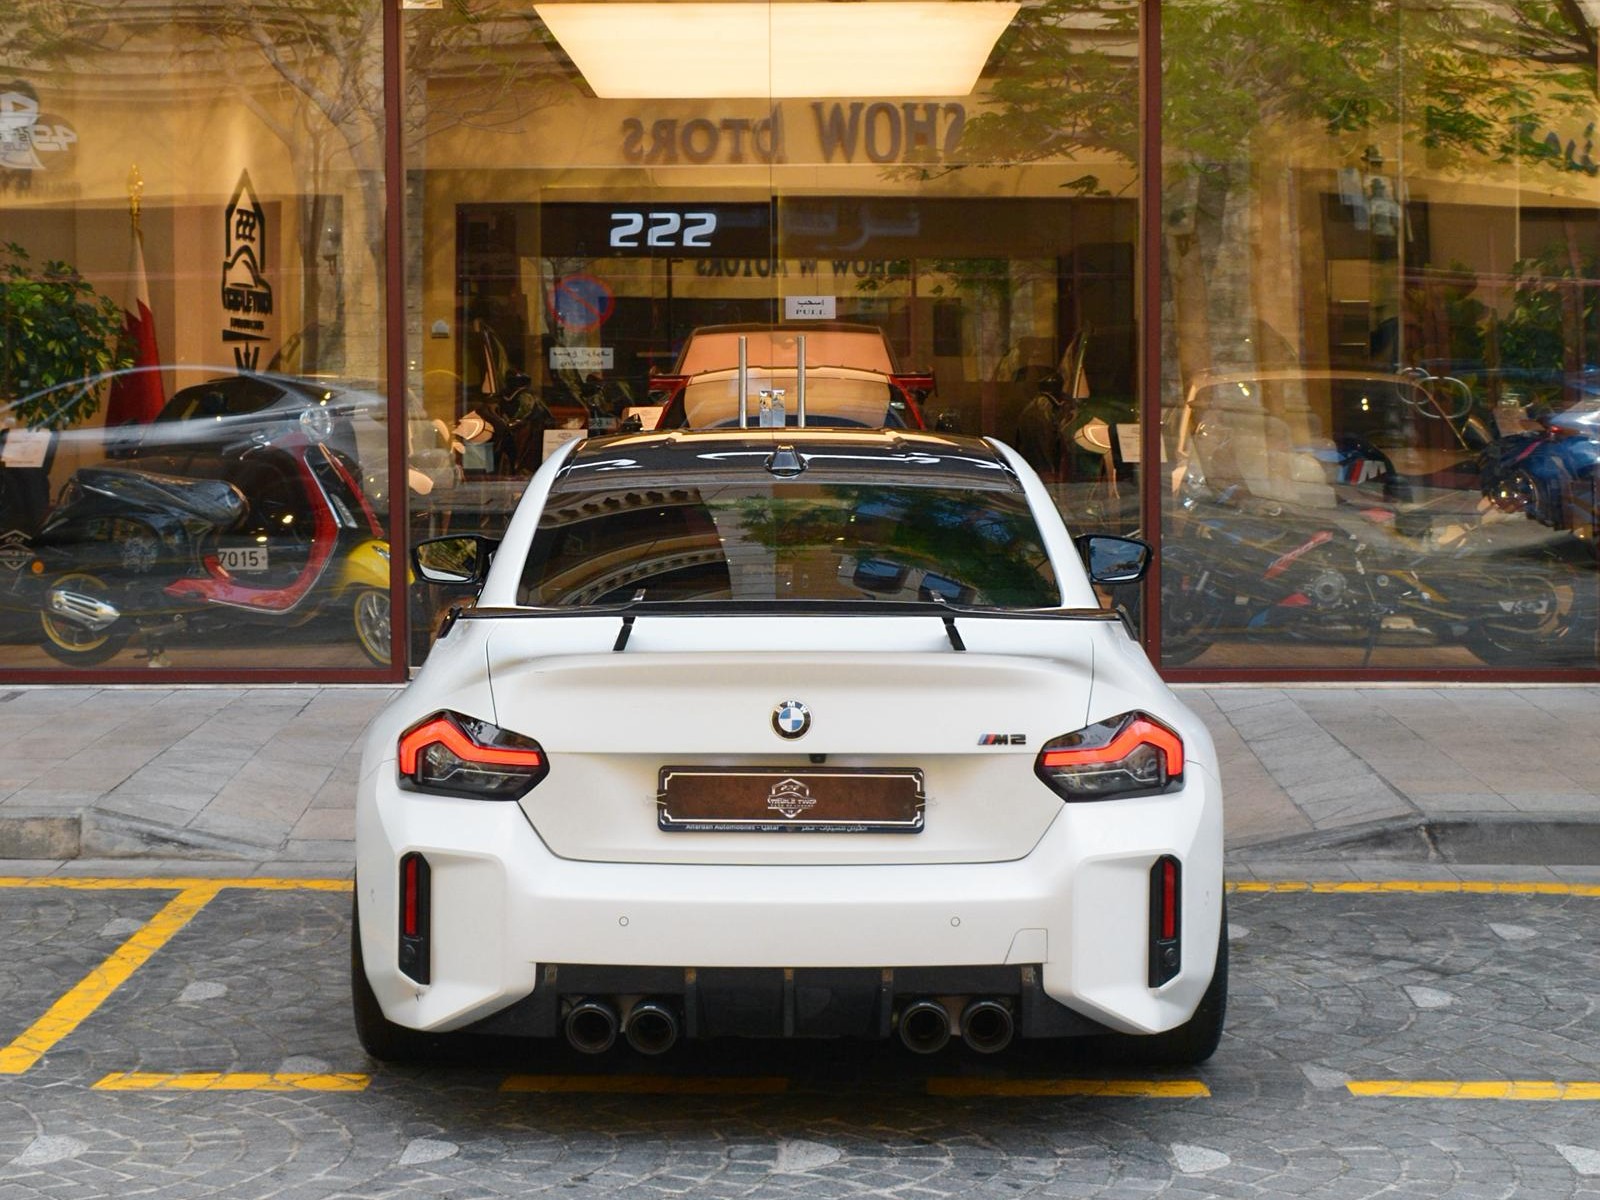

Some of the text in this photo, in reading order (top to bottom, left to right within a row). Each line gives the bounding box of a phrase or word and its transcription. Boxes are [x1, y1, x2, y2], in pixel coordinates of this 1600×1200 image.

[610, 213, 717, 247] 222
[219, 550, 259, 567] 7015
[773, 700, 808, 713] BMW
[978, 734, 1026, 745] M2
